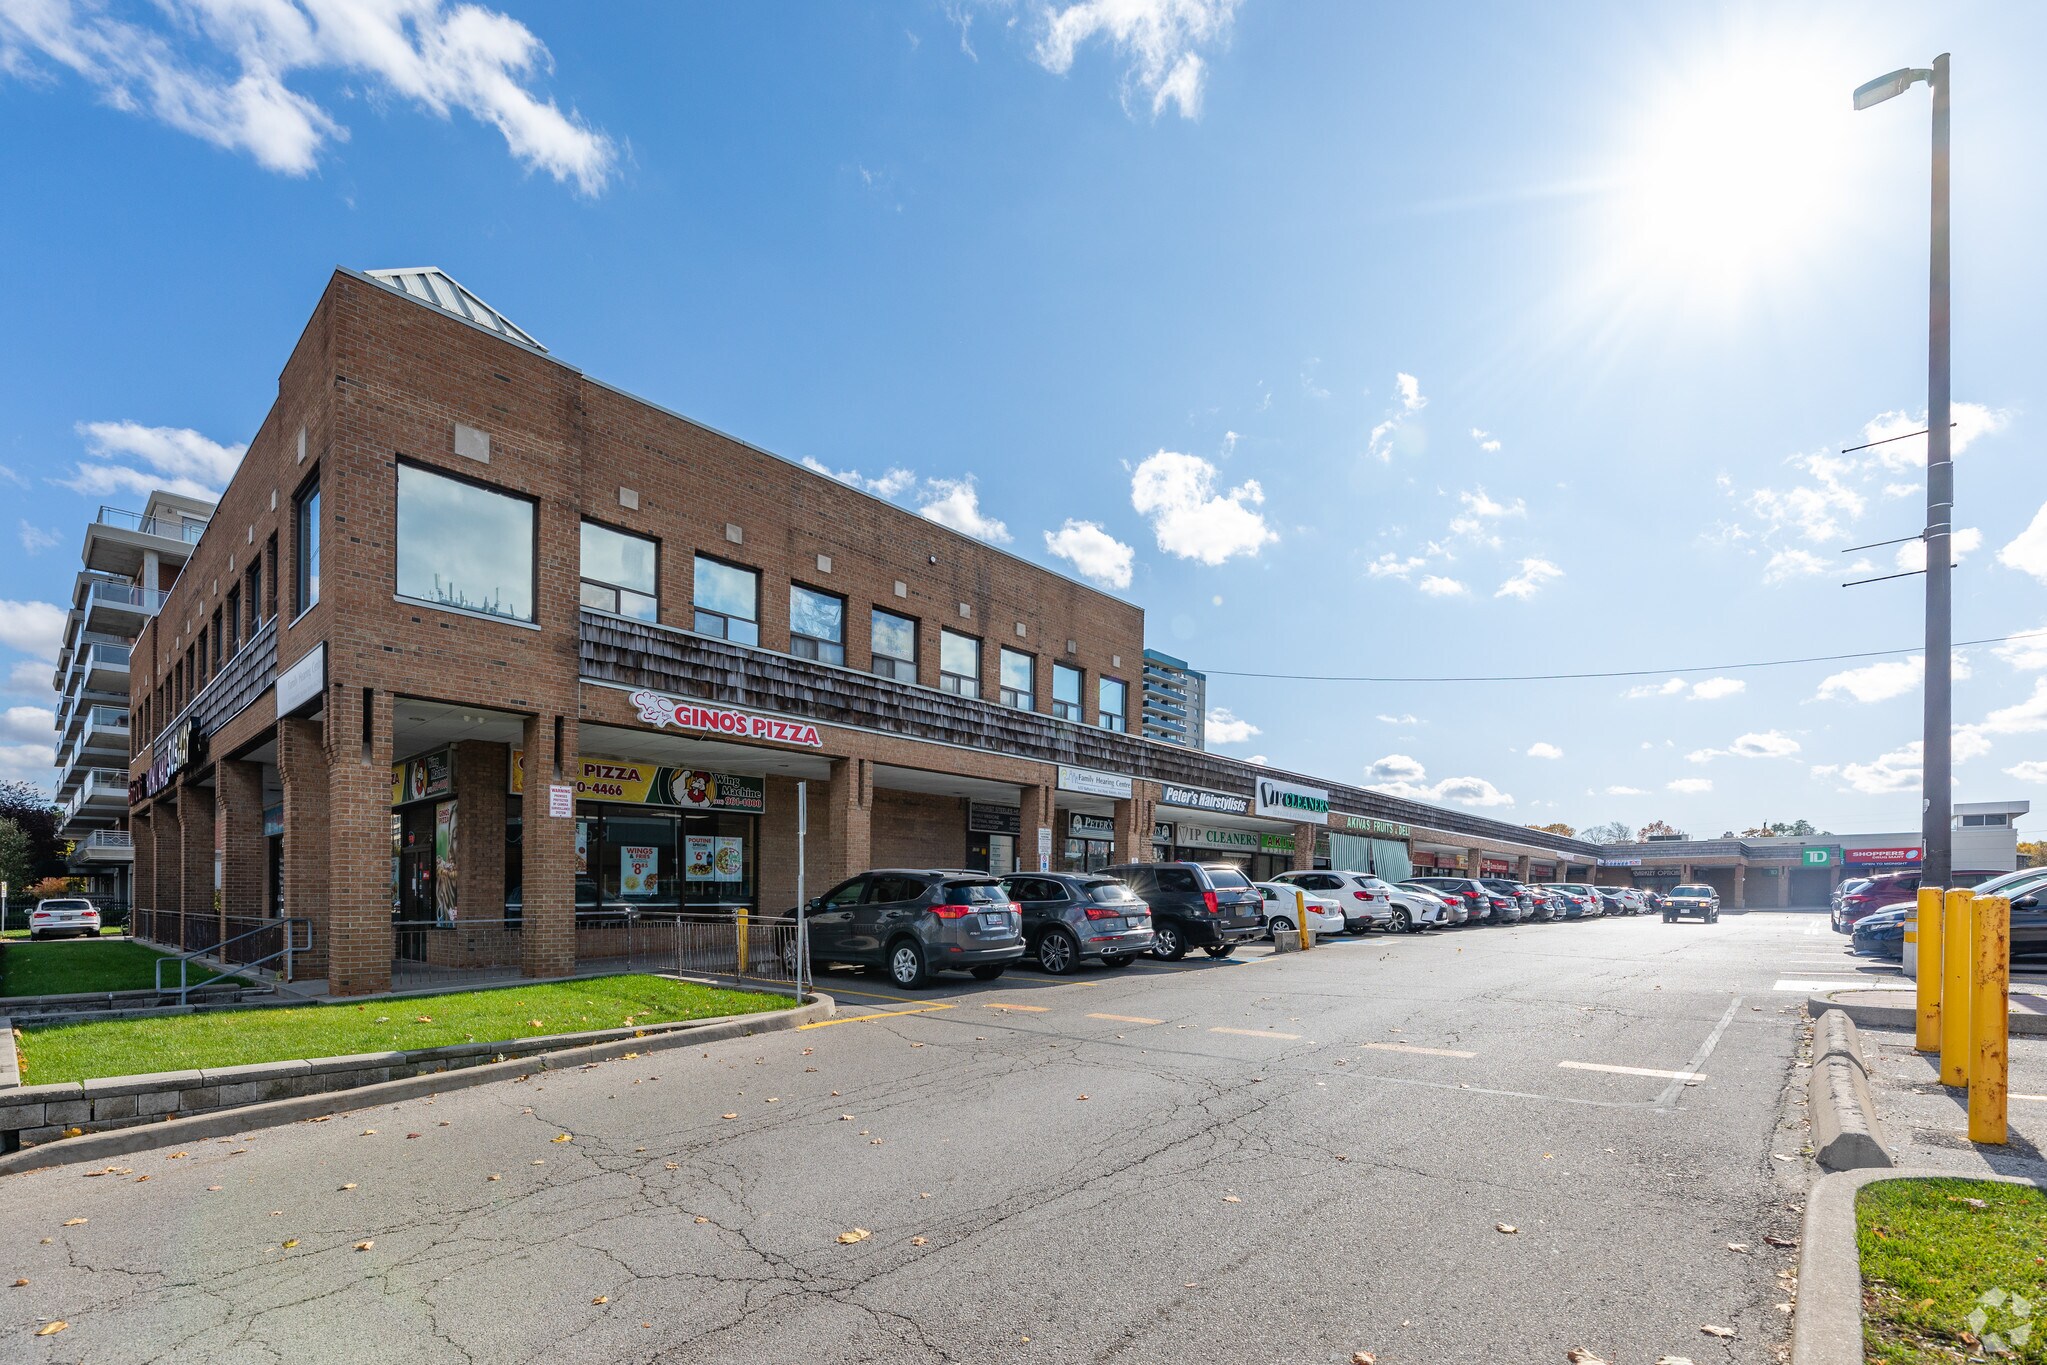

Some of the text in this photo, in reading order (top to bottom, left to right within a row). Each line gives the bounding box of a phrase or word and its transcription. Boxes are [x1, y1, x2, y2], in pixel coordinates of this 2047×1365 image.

[674, 706, 819, 745] GINO'S PIZZA
[583, 763, 643, 782] PIZZA
[714, 774, 740, 788] Wing
[1078, 773, 1131, 789] Family Hearing Centre
[722, 785, 762, 798] Machine
[1165, 787, 1199, 805] Peter's
[1285, 793, 1329, 813] CLEANERS
[1085, 817, 1114, 831] PETER'S
[1347, 817, 1371, 831] AKIVAS
[1373, 821, 1394, 834] FRUITS
[1398, 826, 1411, 836] DELI
[1179, 825, 1202, 845] VIP
[1206, 830, 1257, 846] CLEANERS
[1806, 851, 1827, 863] TD
